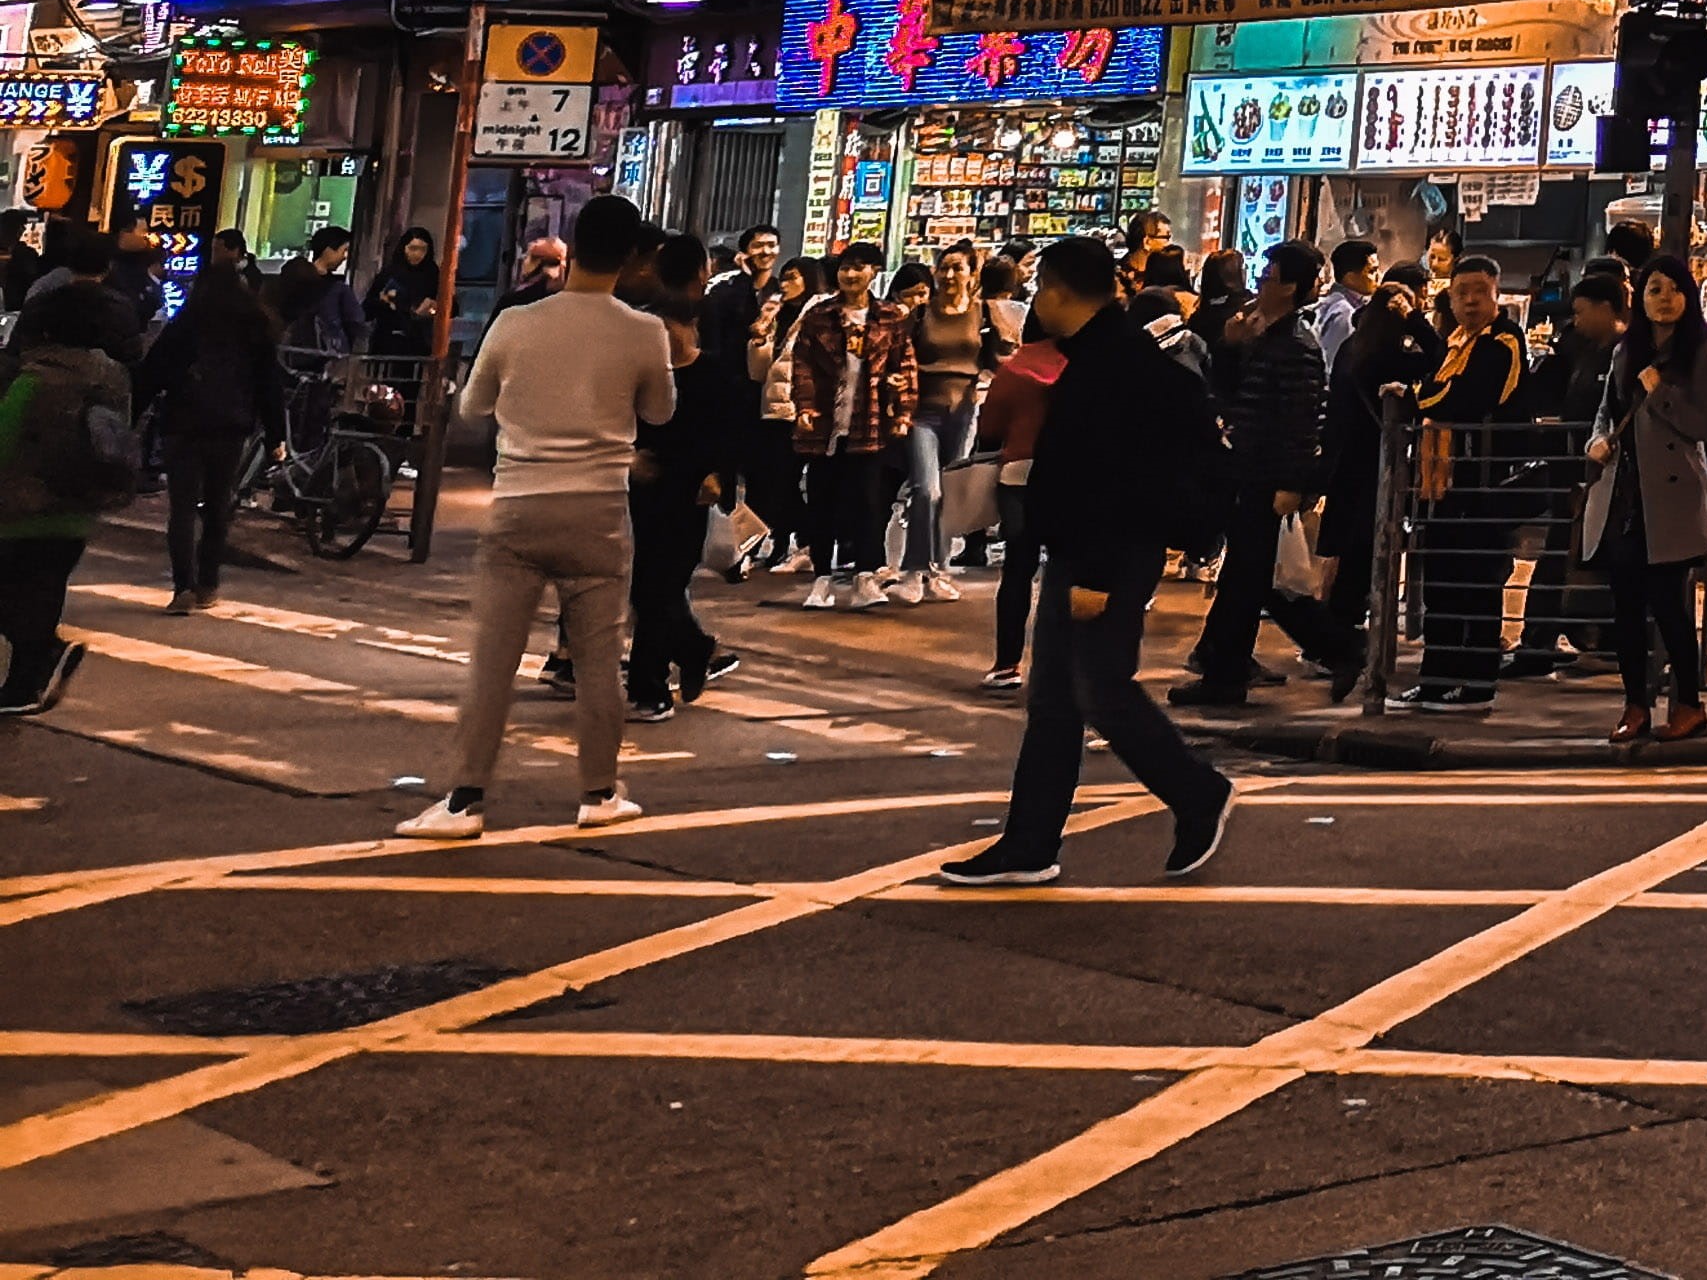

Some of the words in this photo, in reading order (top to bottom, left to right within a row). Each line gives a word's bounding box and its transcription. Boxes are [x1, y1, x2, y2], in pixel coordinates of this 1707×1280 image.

[552, 90, 570, 112] 7
[482, 124, 542, 138] midnight
[549, 129, 581, 152] 12
[25, 142, 51, 203] ラーメン
